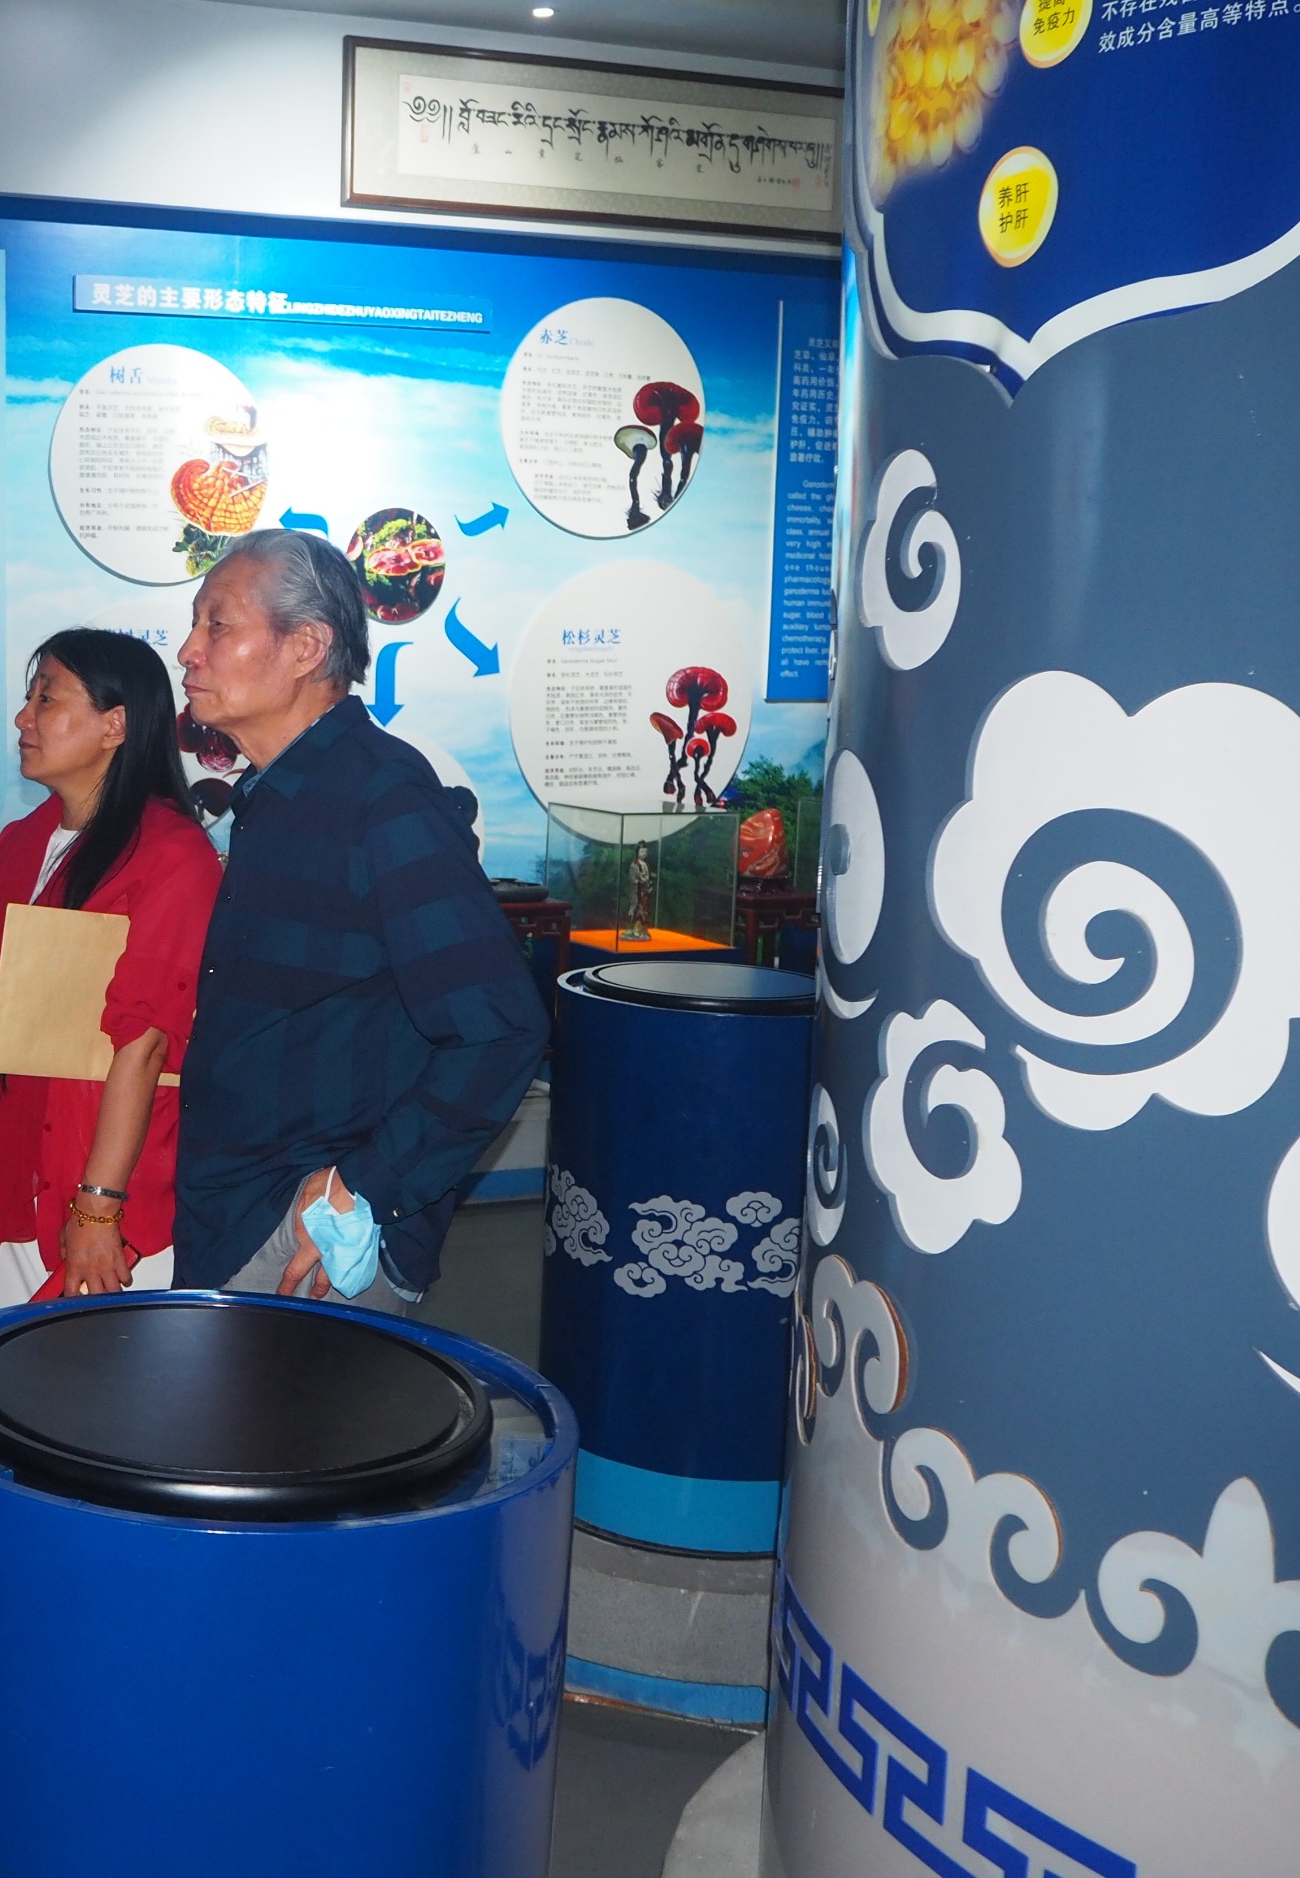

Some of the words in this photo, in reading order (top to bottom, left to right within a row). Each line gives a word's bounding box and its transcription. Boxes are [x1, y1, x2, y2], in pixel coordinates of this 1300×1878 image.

[1033, 7, 1075, 36] 免疫力
[998, 182, 1030, 208] 养肝
[999, 208, 1028, 234] 护肝
[92, 282, 288, 315] 灵芝的主要形态特征
[540, 329, 569, 346] 赤芝
[109, 366, 143, 385] 树舌
[562, 629, 621, 645] 松杉灵芝
